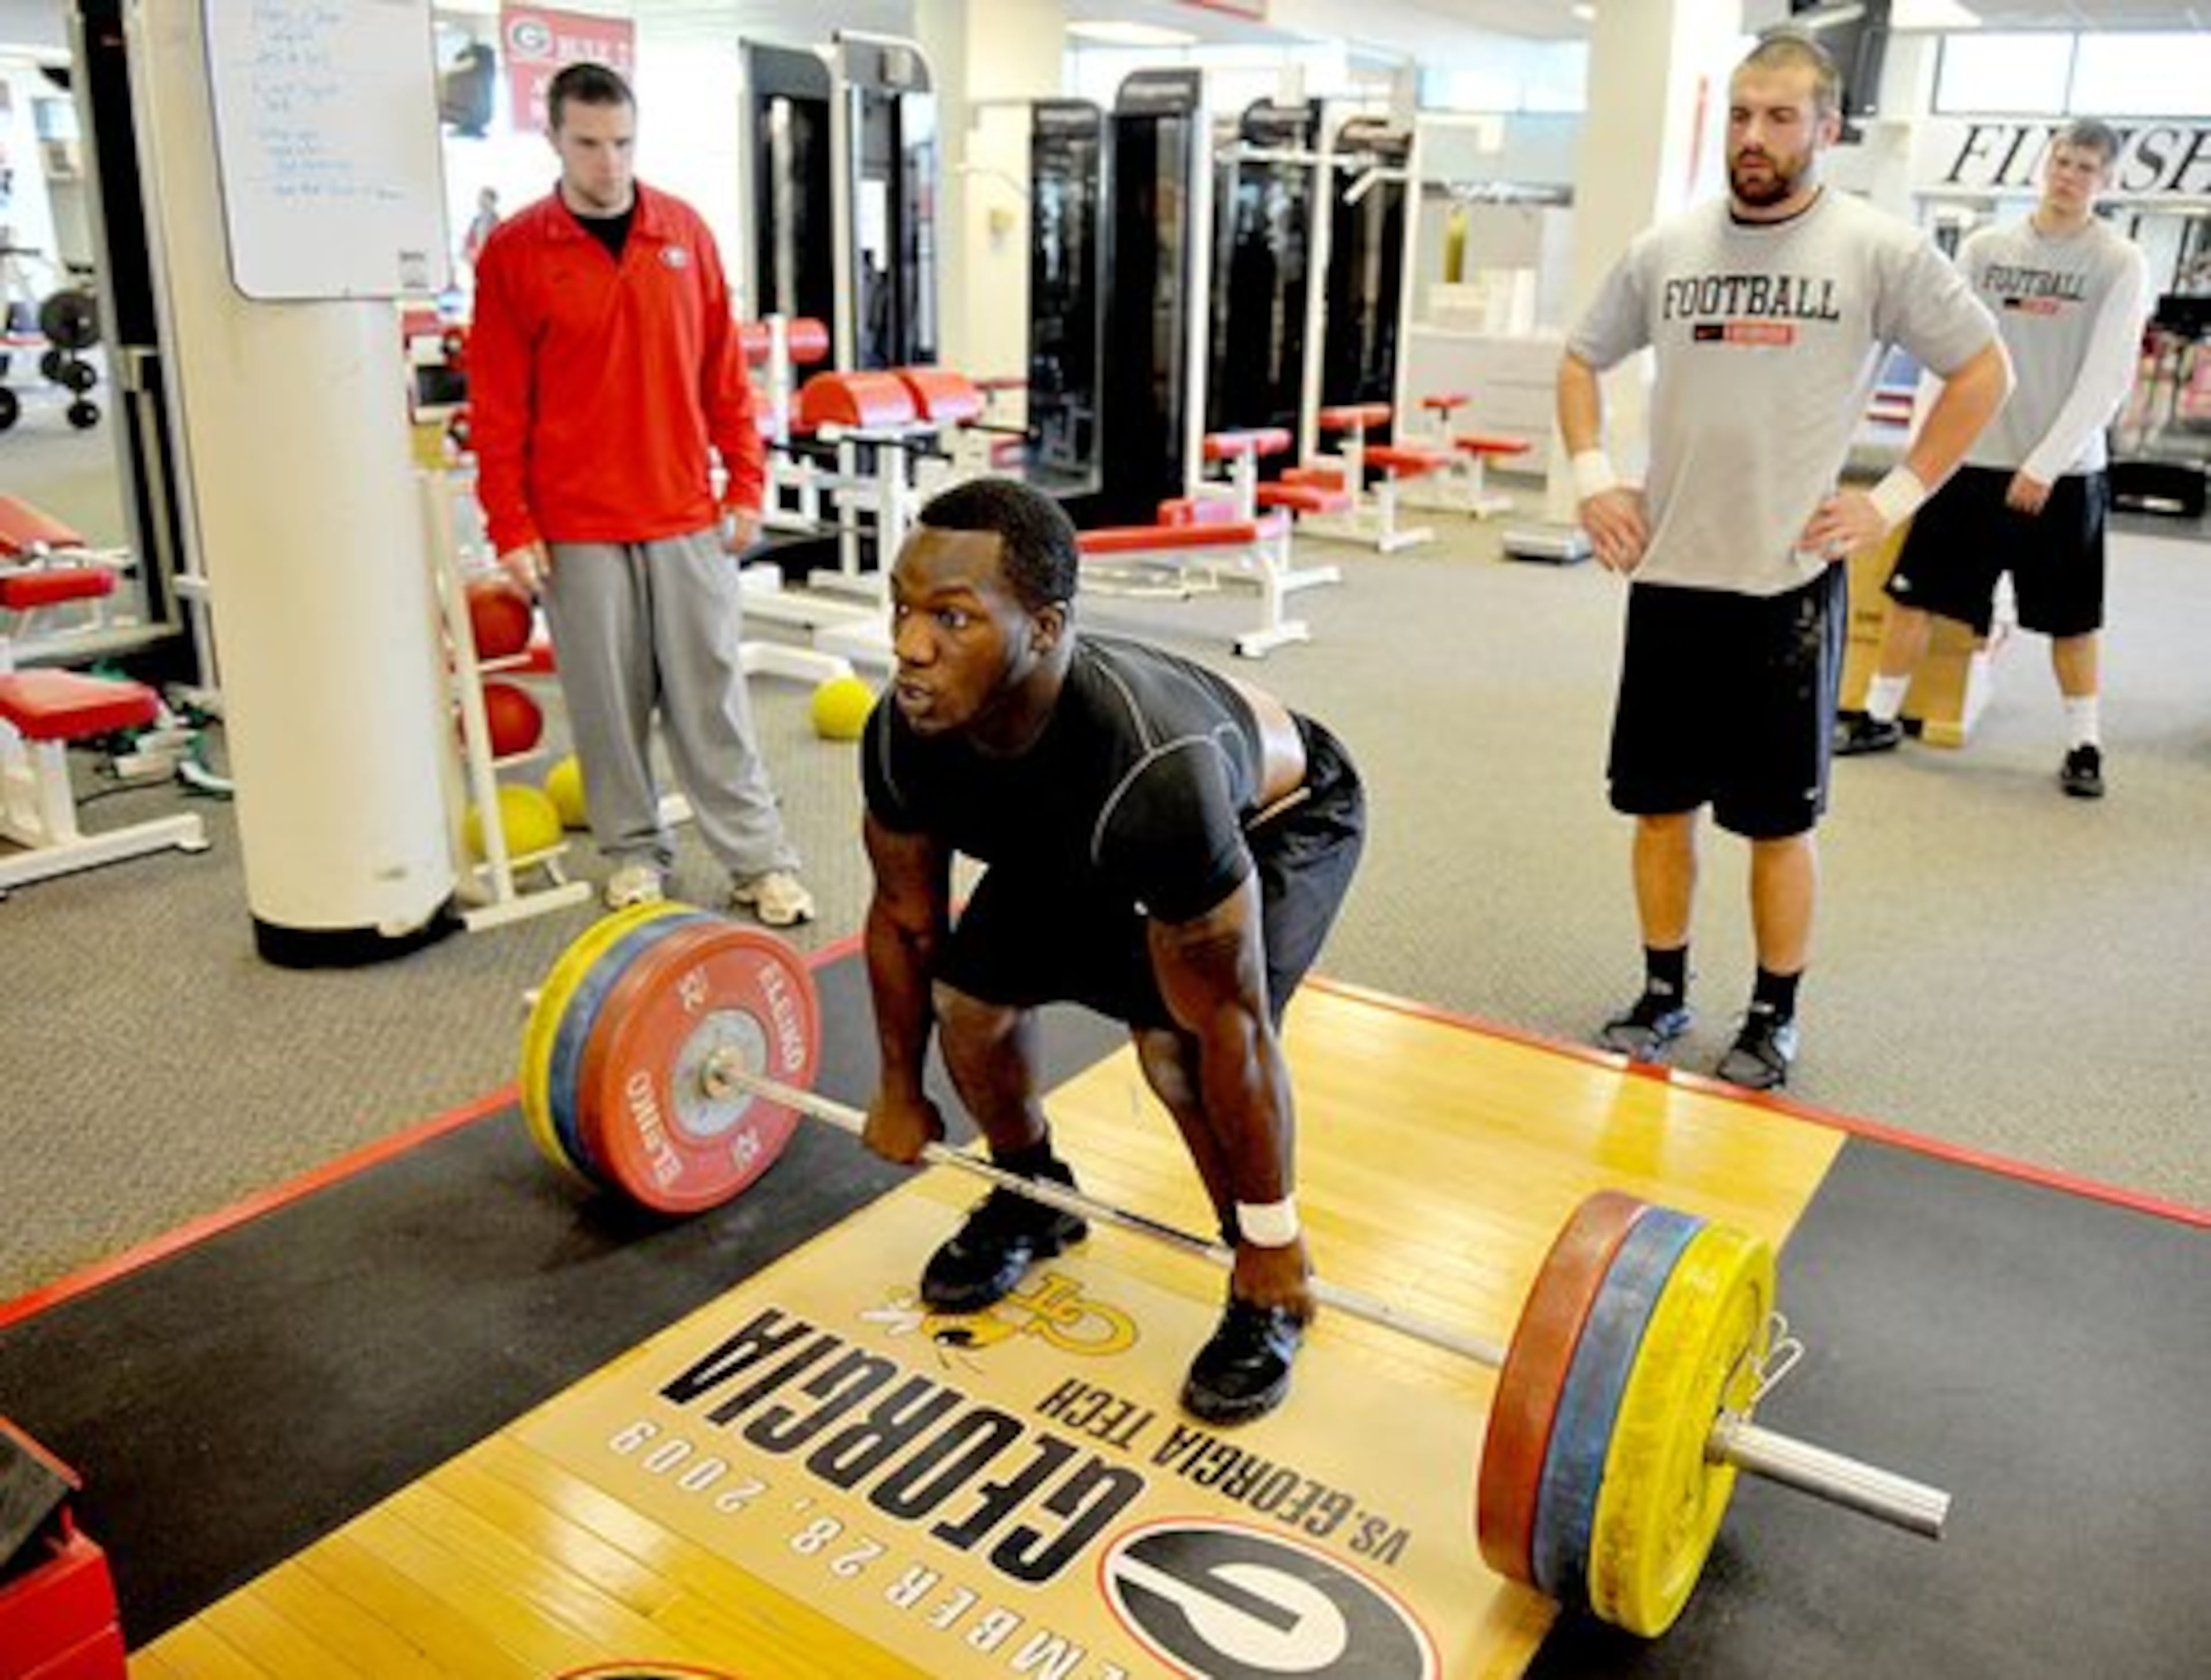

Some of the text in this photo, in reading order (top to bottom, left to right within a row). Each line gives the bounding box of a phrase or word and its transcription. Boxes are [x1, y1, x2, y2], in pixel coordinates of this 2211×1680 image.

[1944, 123, 2211, 193] FISH
[1663, 273, 1840, 321] FOOTBALL
[1982, 262, 2088, 303] FOOTBALL
[658, 1307, 1145, 1585] GEORGIA
[1035, 1378, 1156, 1452] TECH
[608, 1420, 768, 1513] 2009
[1152, 1423, 1354, 1539] GEORGIA
